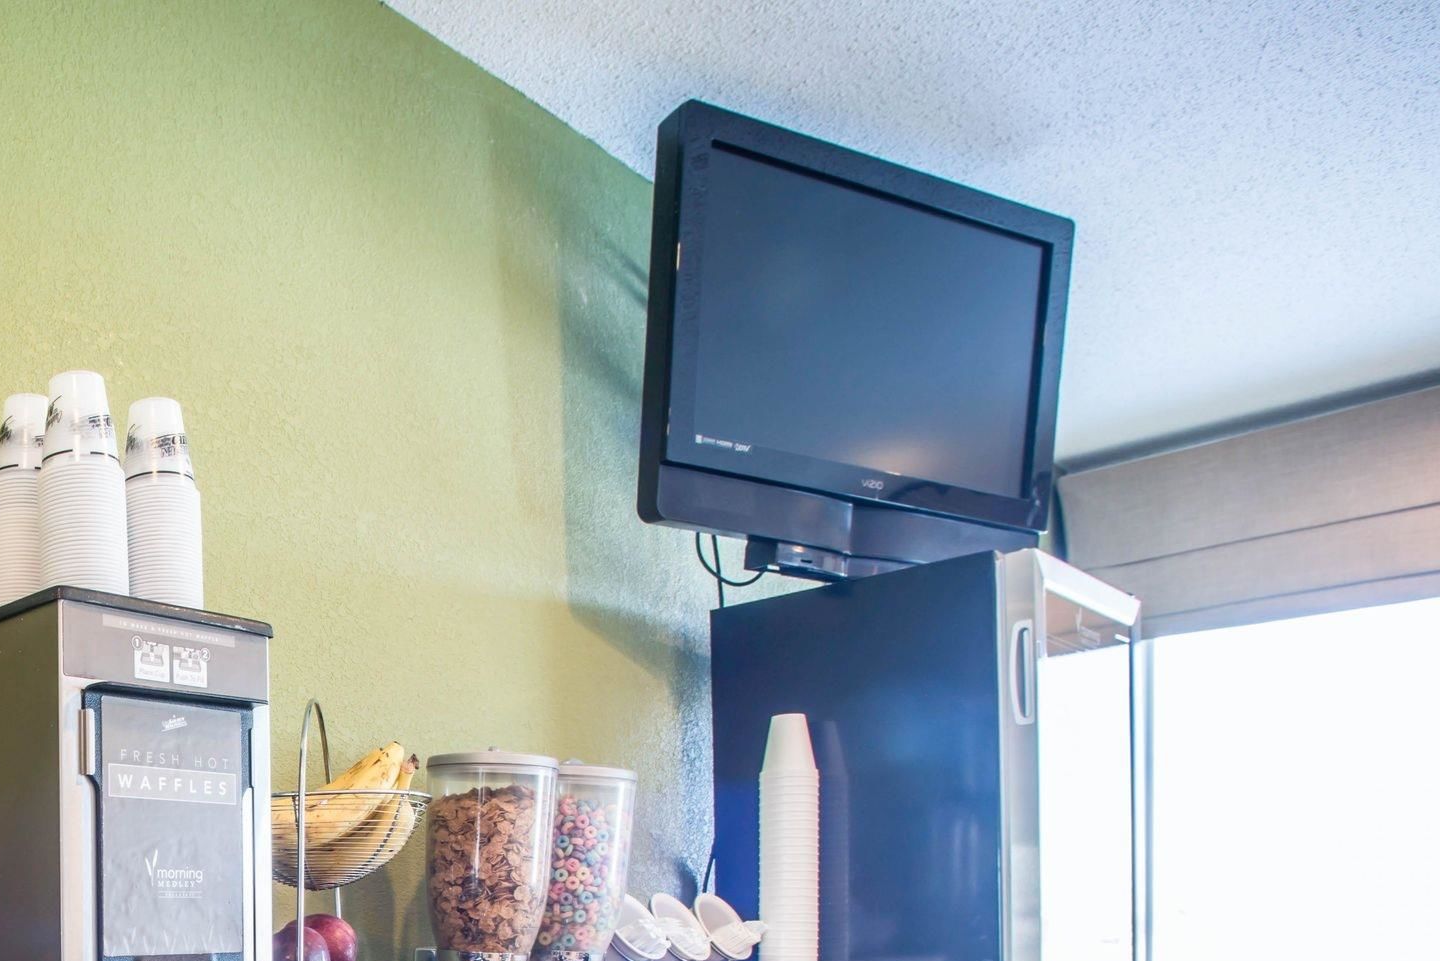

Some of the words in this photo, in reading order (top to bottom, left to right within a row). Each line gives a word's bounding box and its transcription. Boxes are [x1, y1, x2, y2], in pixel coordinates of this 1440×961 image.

[120, 749, 180, 766] FRESH
[194, 756, 229, 770] HOT
[118, 773, 228, 796] WAFFLES
[157, 866, 203, 884] morning
[157, 880, 196, 888] MEDLEY
